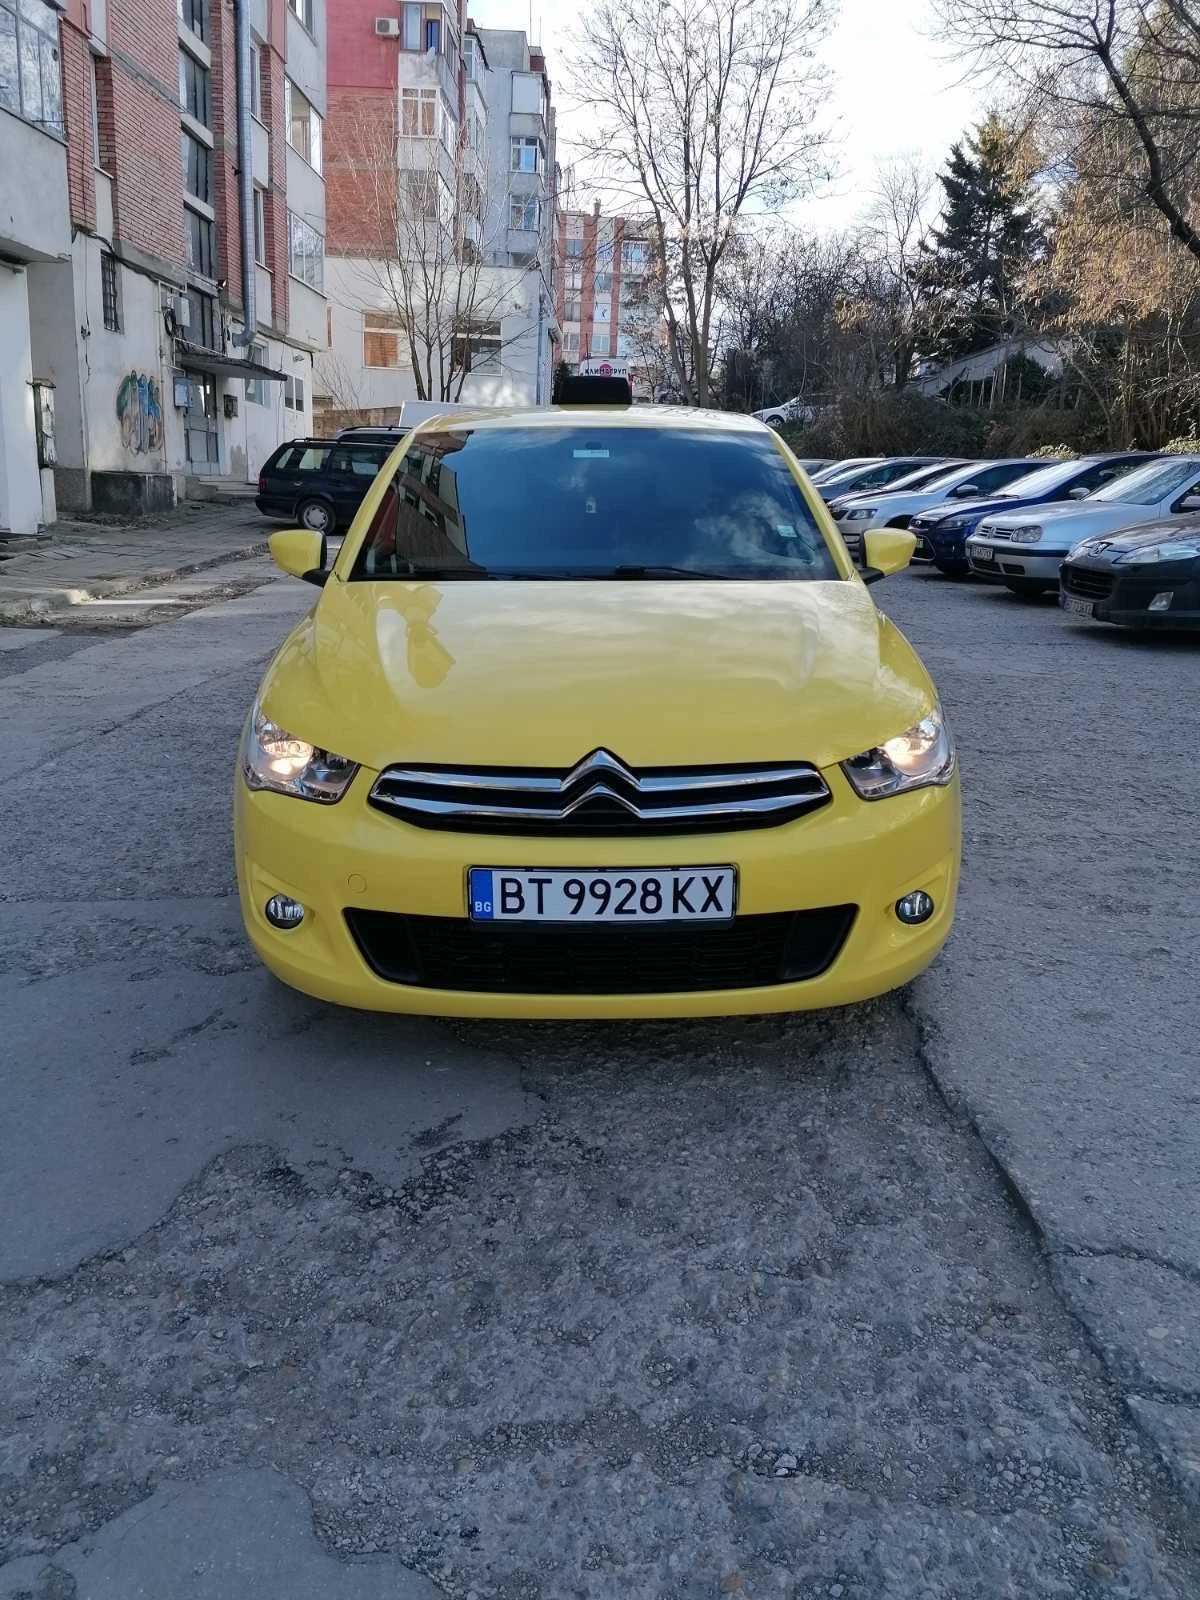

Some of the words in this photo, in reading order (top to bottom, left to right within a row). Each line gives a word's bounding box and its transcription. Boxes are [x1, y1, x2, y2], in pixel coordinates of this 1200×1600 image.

[474, 901, 491, 913] BG
[500, 877, 552, 914] BT
[563, 878, 662, 914] 9928
[672, 875, 725, 914] KX
